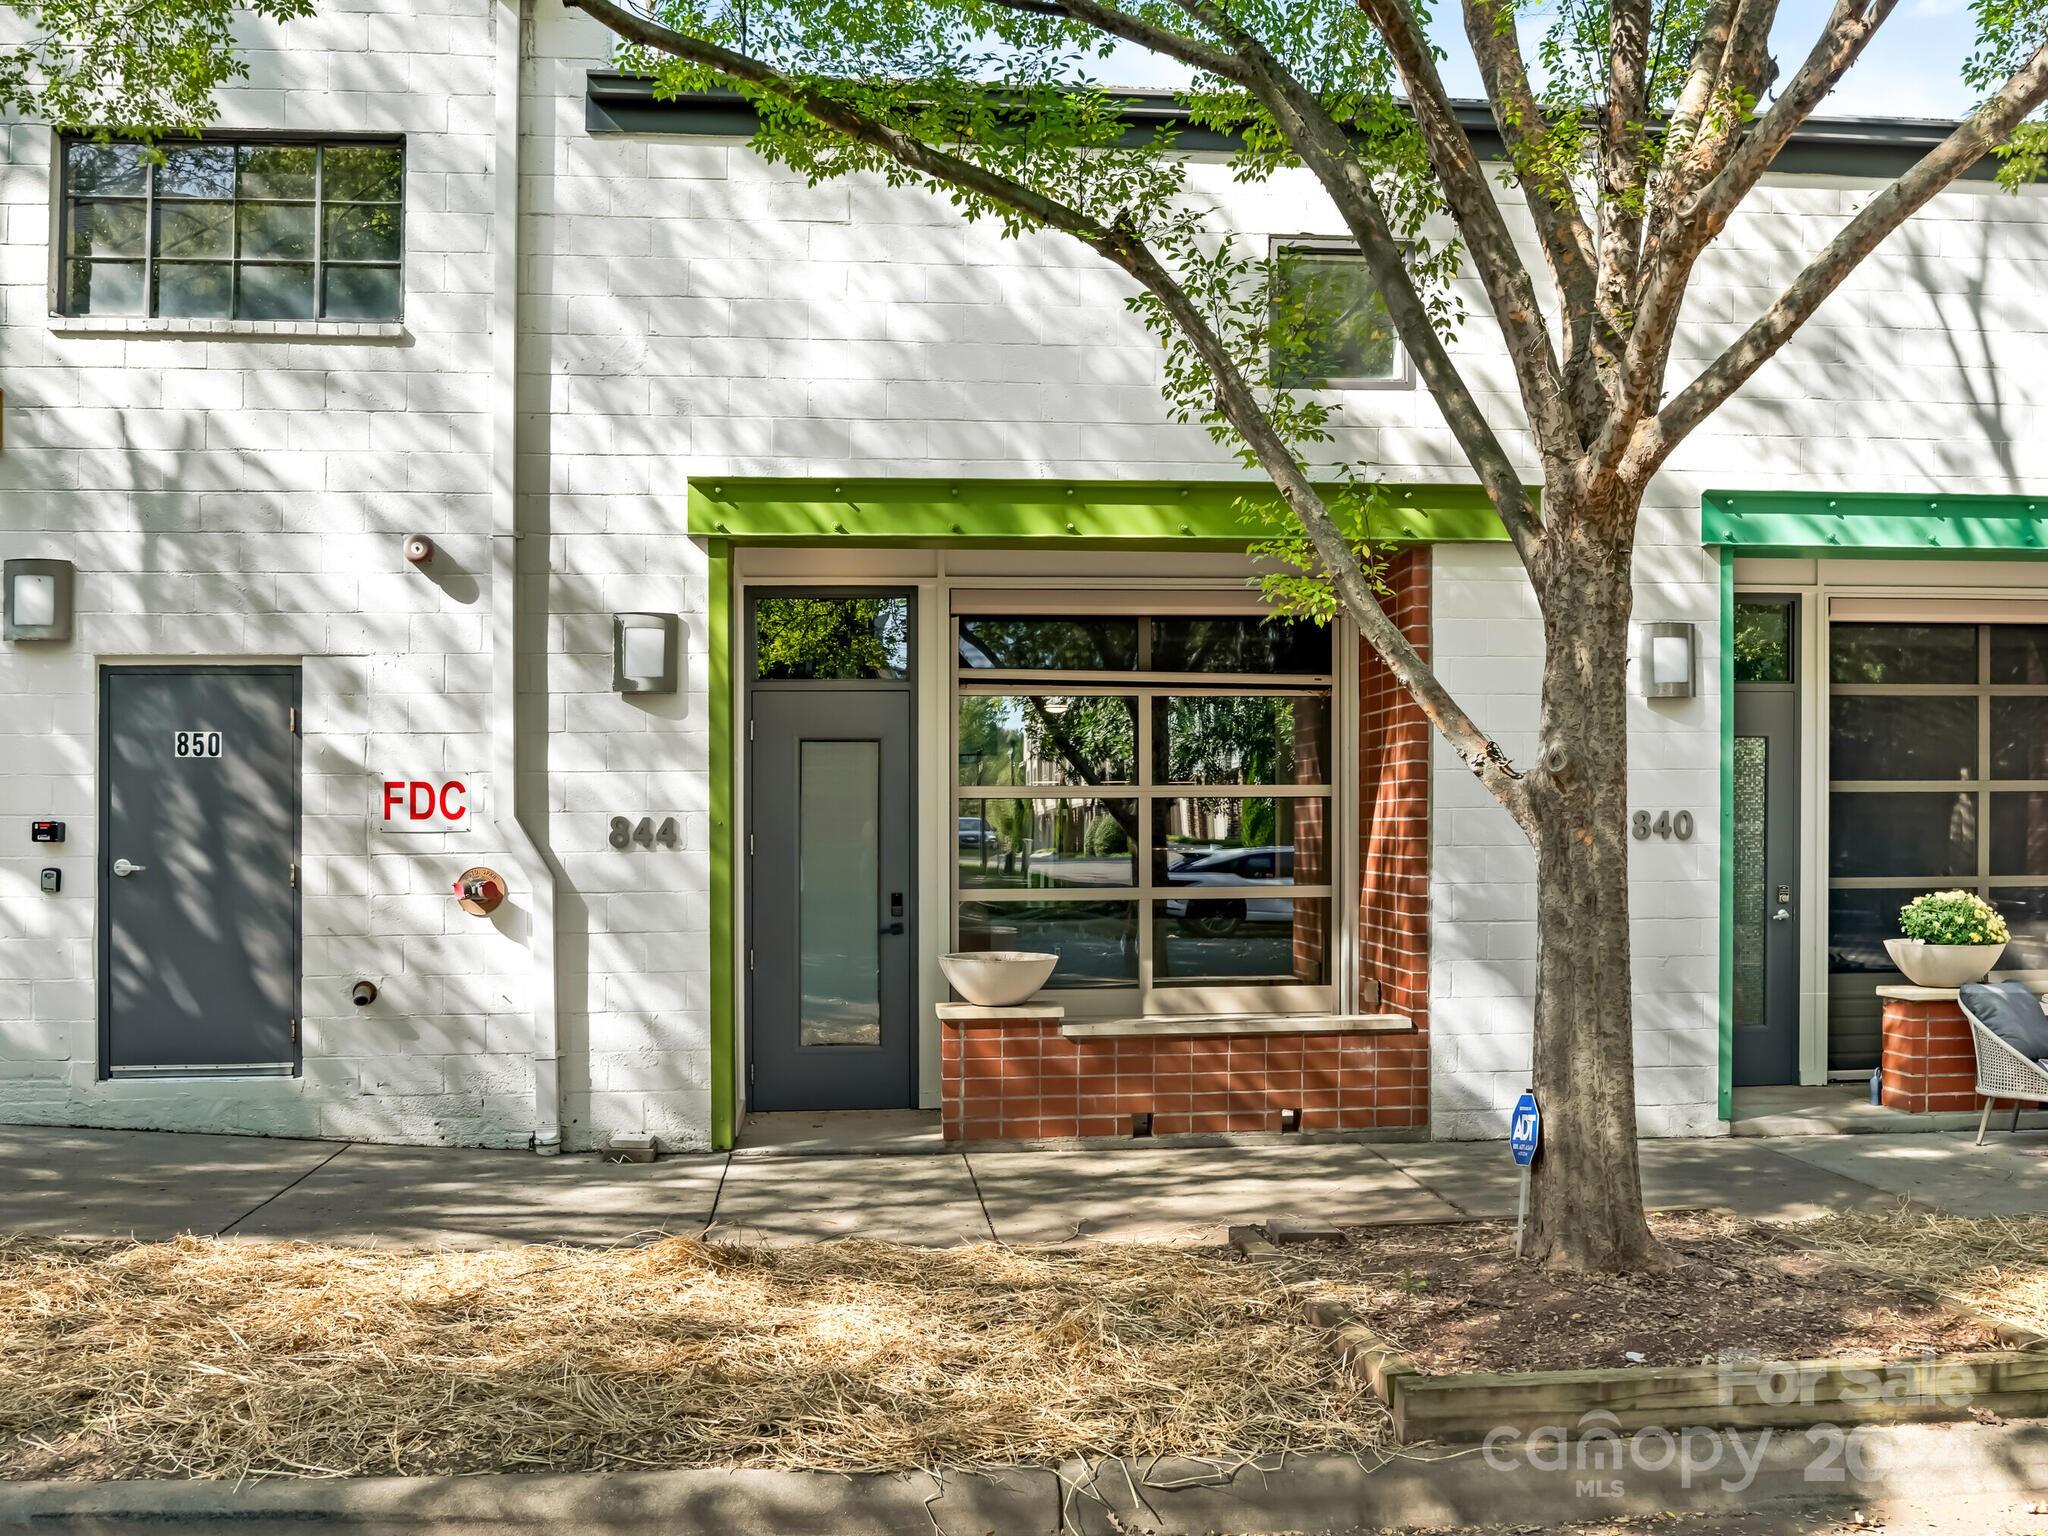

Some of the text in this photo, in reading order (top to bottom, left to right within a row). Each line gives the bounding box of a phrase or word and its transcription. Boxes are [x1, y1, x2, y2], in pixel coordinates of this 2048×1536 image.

[175, 732, 221, 757] 850
[384, 780, 466, 821] FDC
[608, 815, 680, 849] 844
[1632, 810, 1694, 841] 840
[1512, 1114, 1537, 1141] ADT
